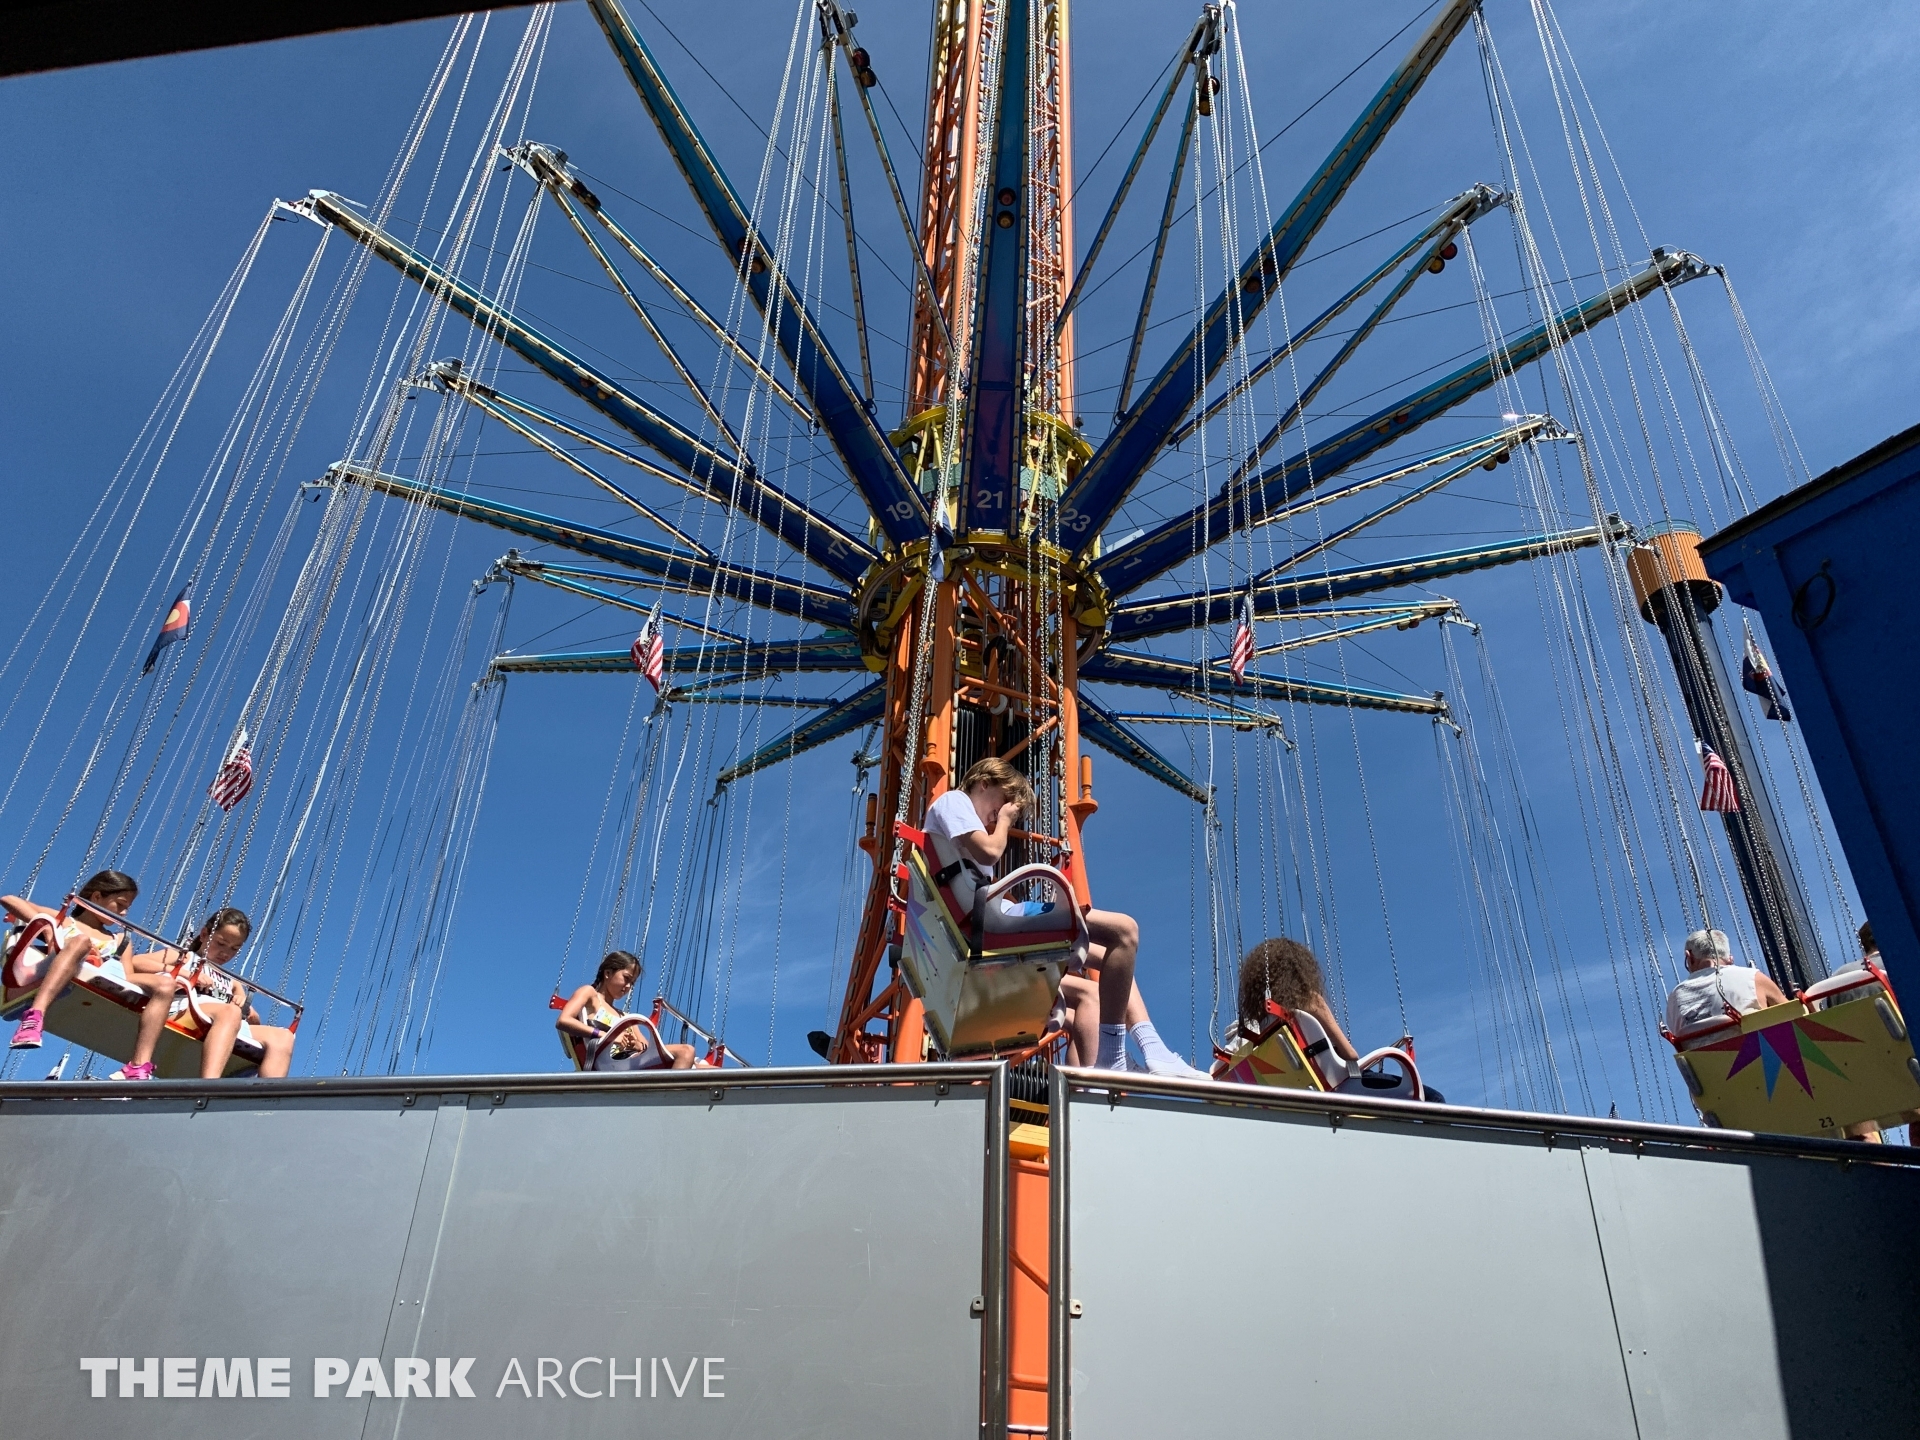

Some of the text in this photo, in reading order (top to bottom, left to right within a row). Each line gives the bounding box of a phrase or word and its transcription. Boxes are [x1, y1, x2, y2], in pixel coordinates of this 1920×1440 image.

[976, 489, 1002, 509] 21
[886, 501, 914, 522] 19
[1059, 507, 1091, 532] 23
[828, 539, 849, 560] 17
[1123, 557, 1142, 570] 1
[1135, 613, 1154, 625] 3
[1818, 1116, 1835, 1128] 23
